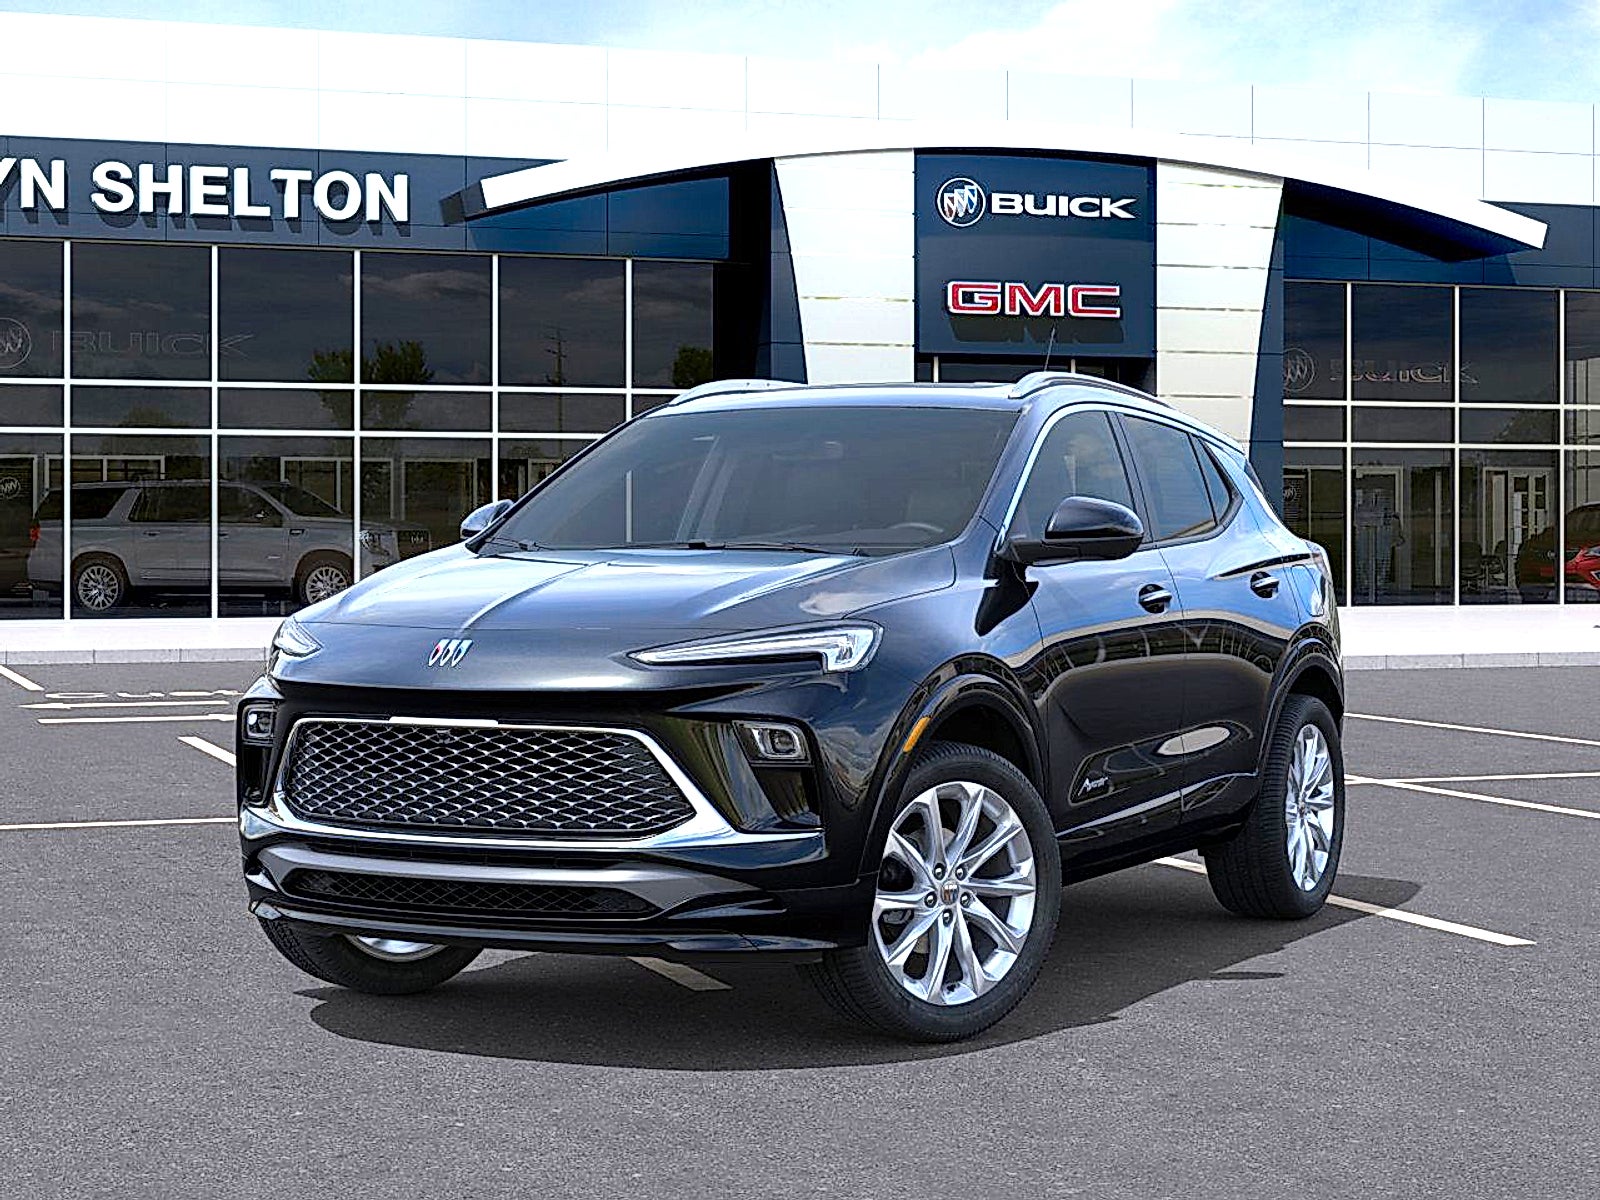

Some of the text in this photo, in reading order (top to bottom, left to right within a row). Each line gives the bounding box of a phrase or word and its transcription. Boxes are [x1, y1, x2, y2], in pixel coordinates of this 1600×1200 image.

[90, 160, 409, 222] SHELTON
[991, 192, 1137, 219] BUICK
[947, 280, 1121, 318] GMC
